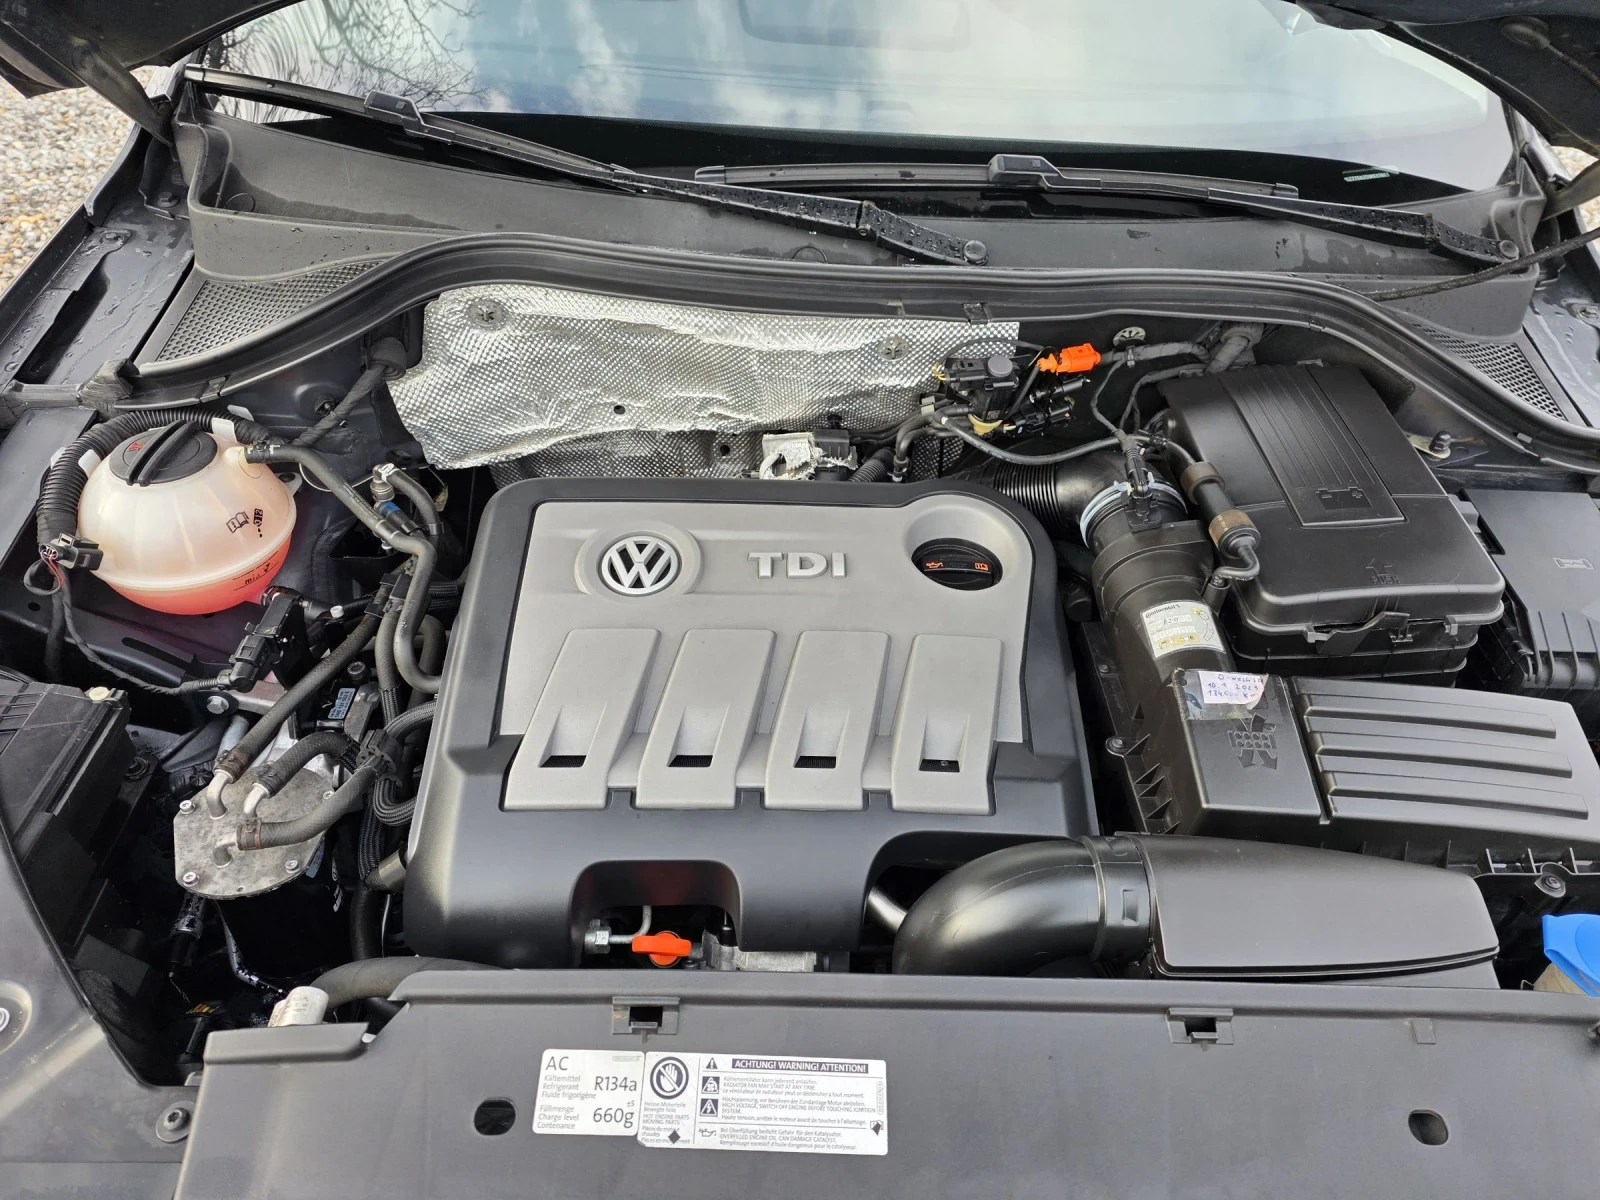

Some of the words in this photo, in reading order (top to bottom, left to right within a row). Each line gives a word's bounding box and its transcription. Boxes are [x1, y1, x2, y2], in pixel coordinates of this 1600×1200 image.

[748, 552, 847, 579] TDI
[545, 1056, 569, 1071] AC
[735, 1060, 776, 1069] ACHTUNG!
[777, 1062, 819, 1071] WARNING!
[820, 1063, 866, 1073] ATTENTION!
[542, 1083, 579, 1091] Refrigerant
[594, 1076, 637, 1092] R134a
[562, 1091, 596, 1100] frigorigène
[540, 1105, 574, 1114] Füllmenge
[538, 1113, 562, 1122] Charge
[593, 1107, 634, 1129] 660g
